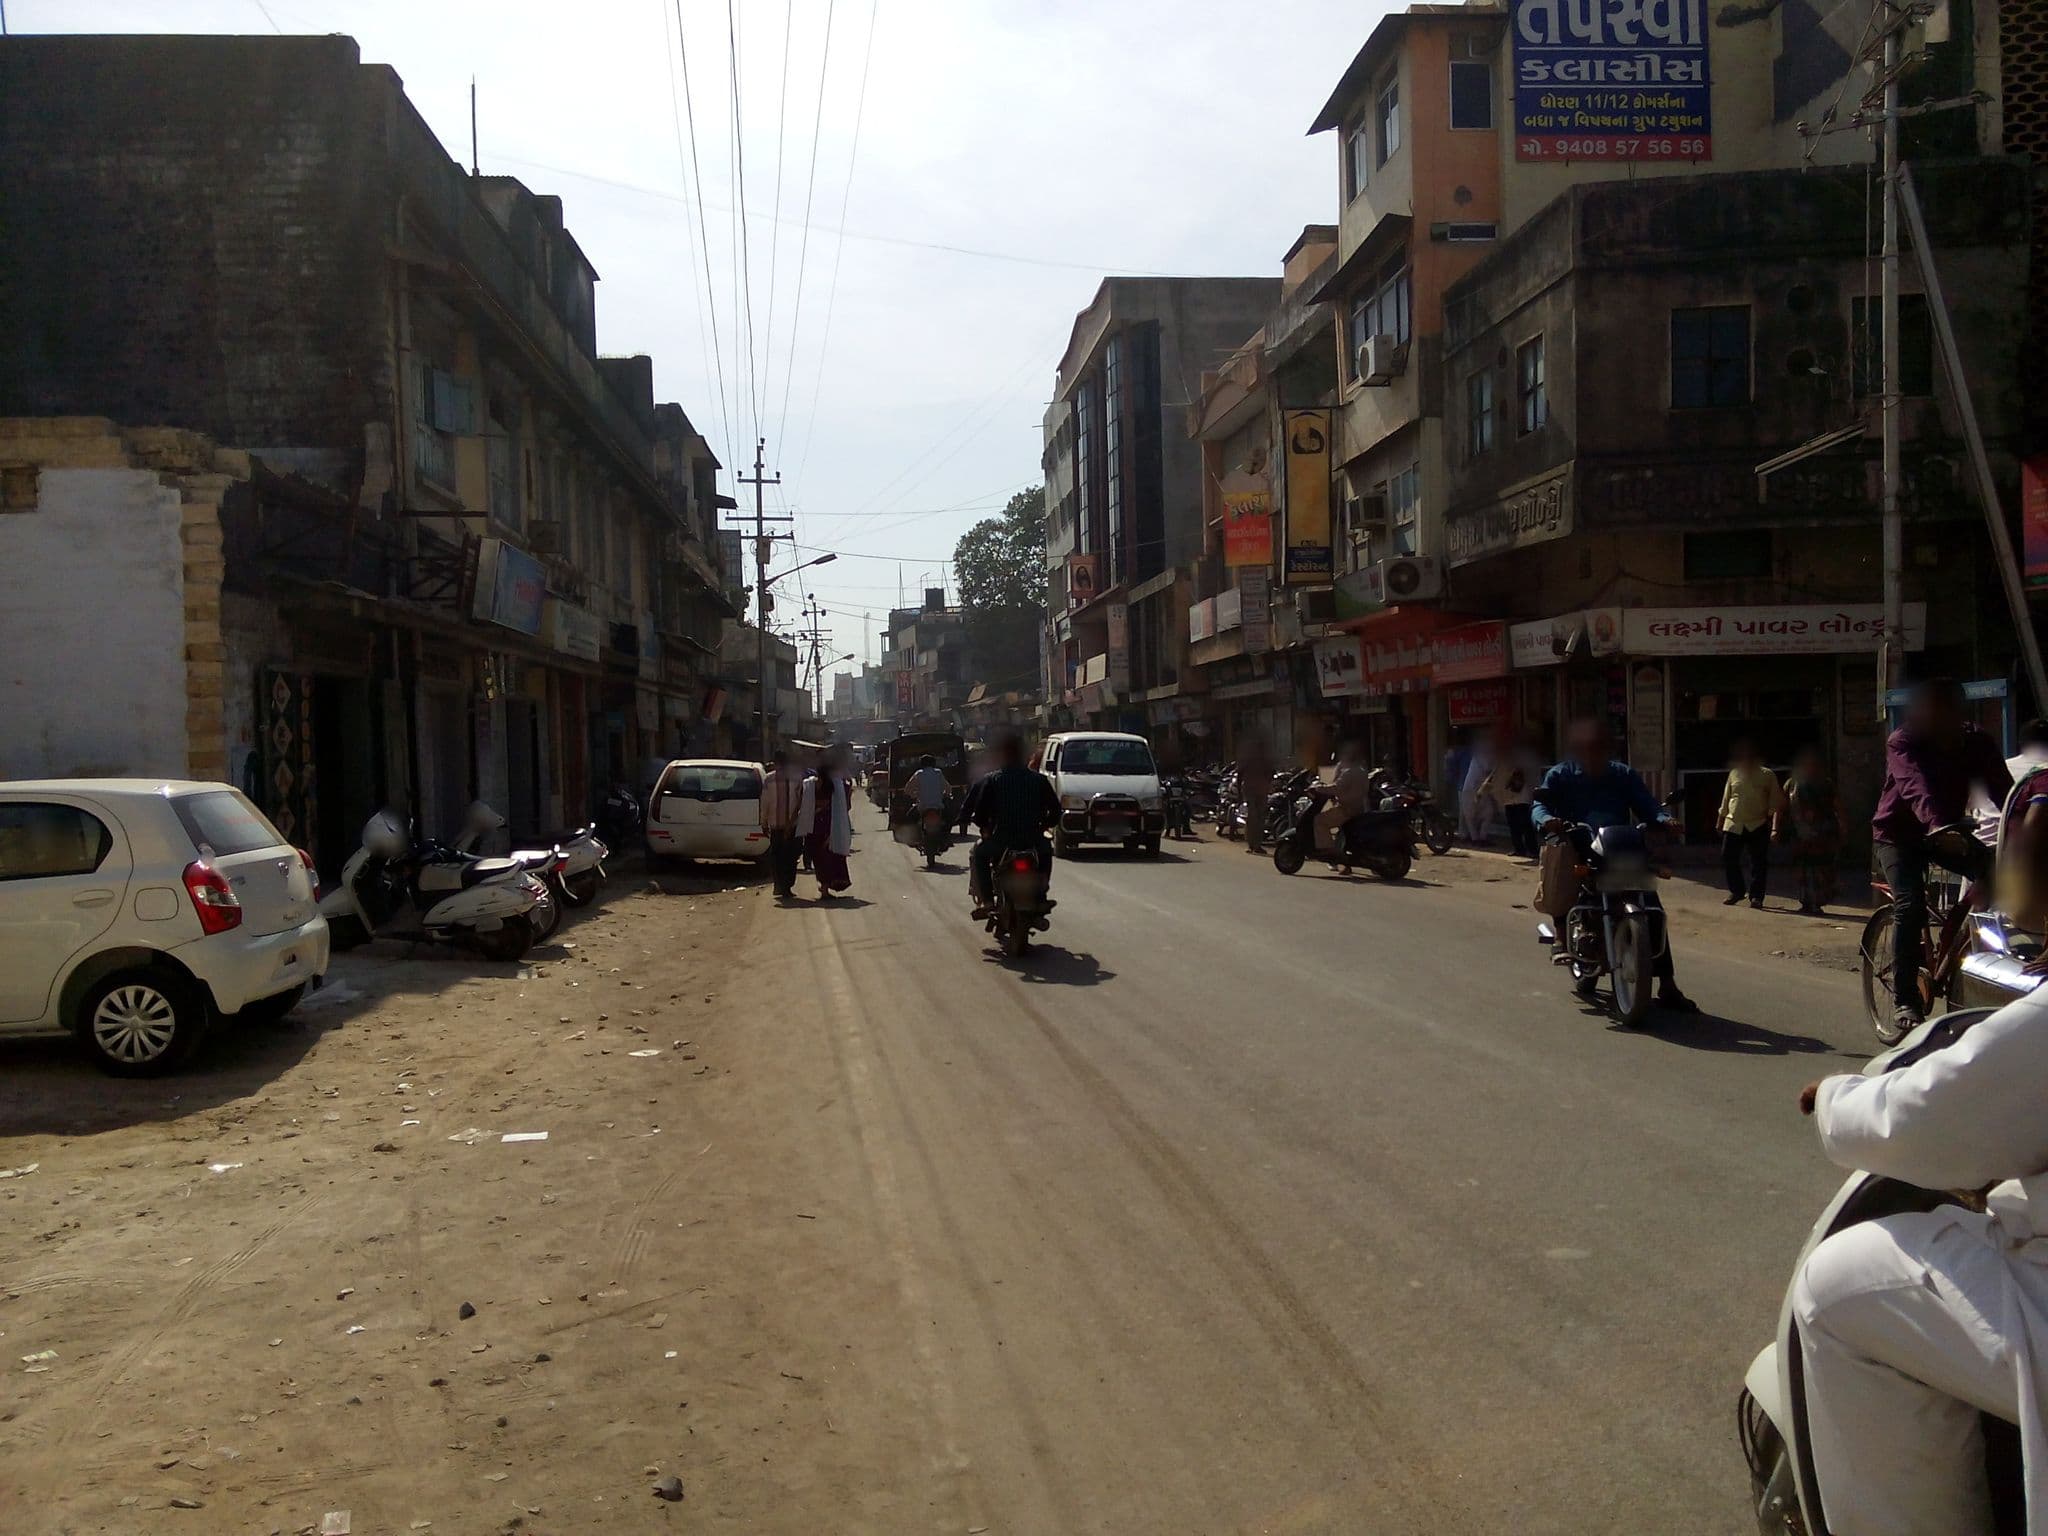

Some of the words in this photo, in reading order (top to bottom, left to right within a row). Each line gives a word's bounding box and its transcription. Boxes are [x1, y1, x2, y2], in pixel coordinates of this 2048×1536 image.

[1540, 93, 1579, 109] ધોરણ
[1585, 93, 1628, 109] 11/12
[1523, 115, 1553, 128] બધા
[1557, 115, 1571, 128] જ
[1556, 140, 1607, 155] 9408
[1615, 140, 1639, 155] 57
[1648, 140, 1672, 155] 56
[1680, 140, 1705, 155] 56
[1649, 616, 1723, 638] લક્ષ્મી
[1735, 619, 1809, 636] પાવર
